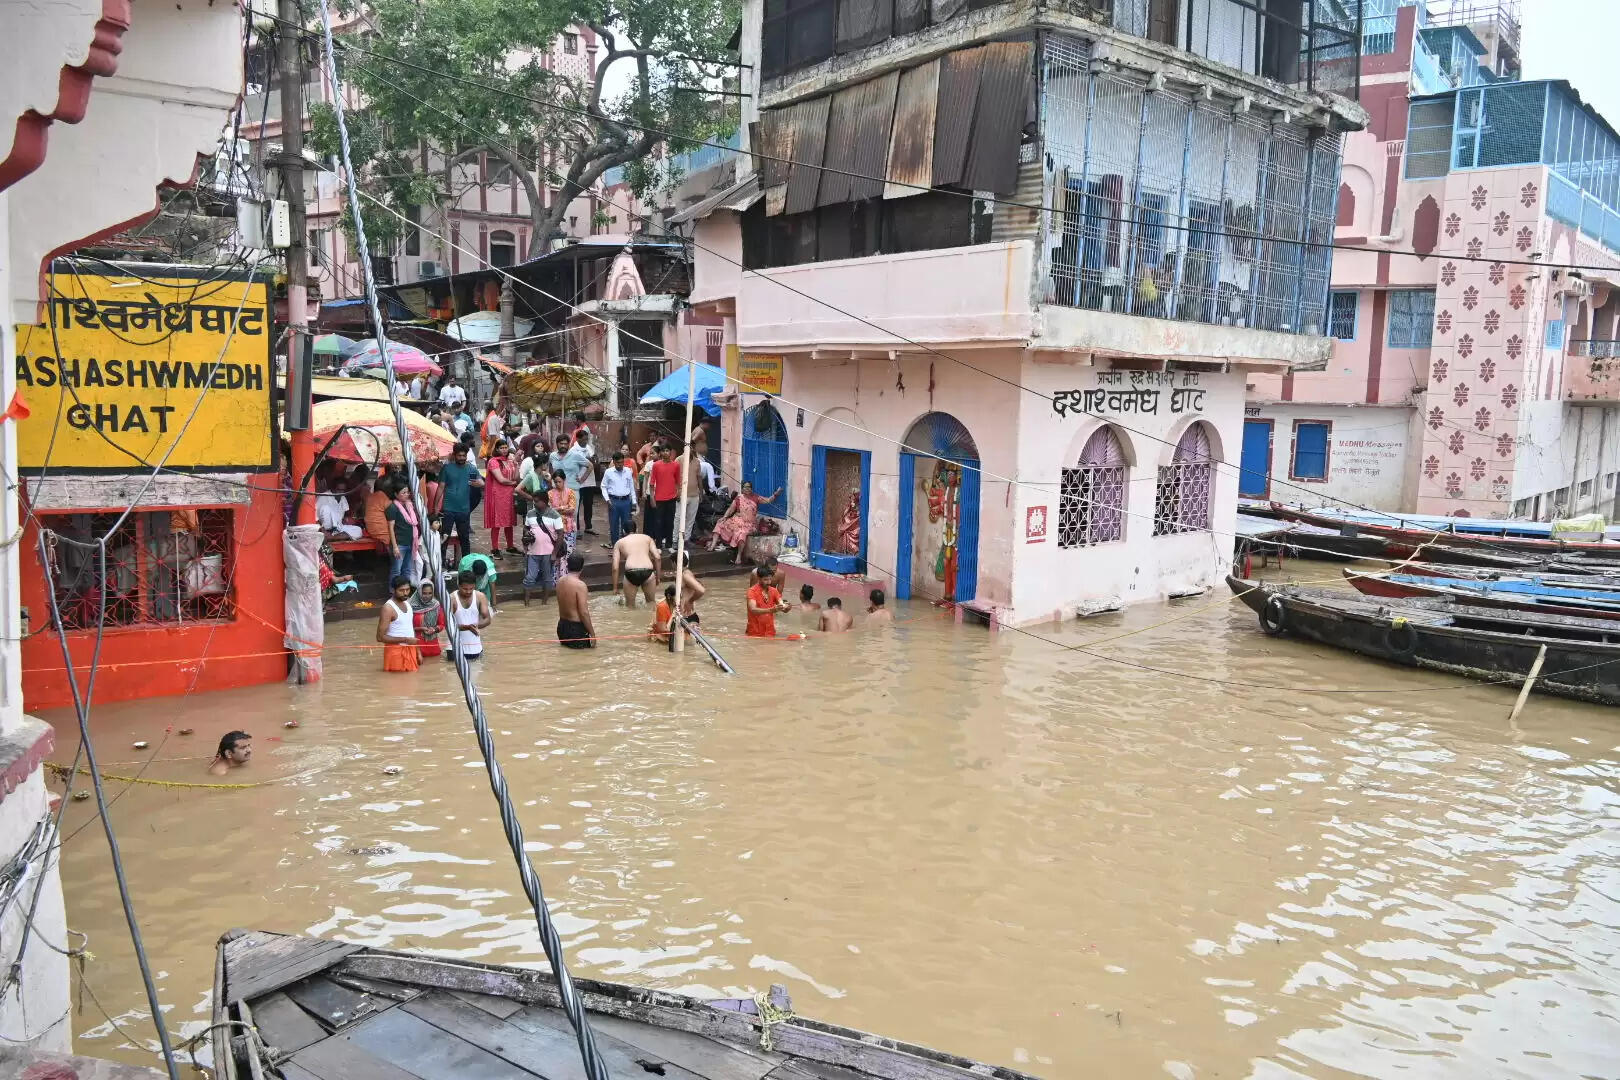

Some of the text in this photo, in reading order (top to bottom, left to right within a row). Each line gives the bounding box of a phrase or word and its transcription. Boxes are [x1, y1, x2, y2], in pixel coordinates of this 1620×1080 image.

[1053, 384, 1206, 418] दशाश्वमेध घाट
[66, 403, 175, 433] GHAT
